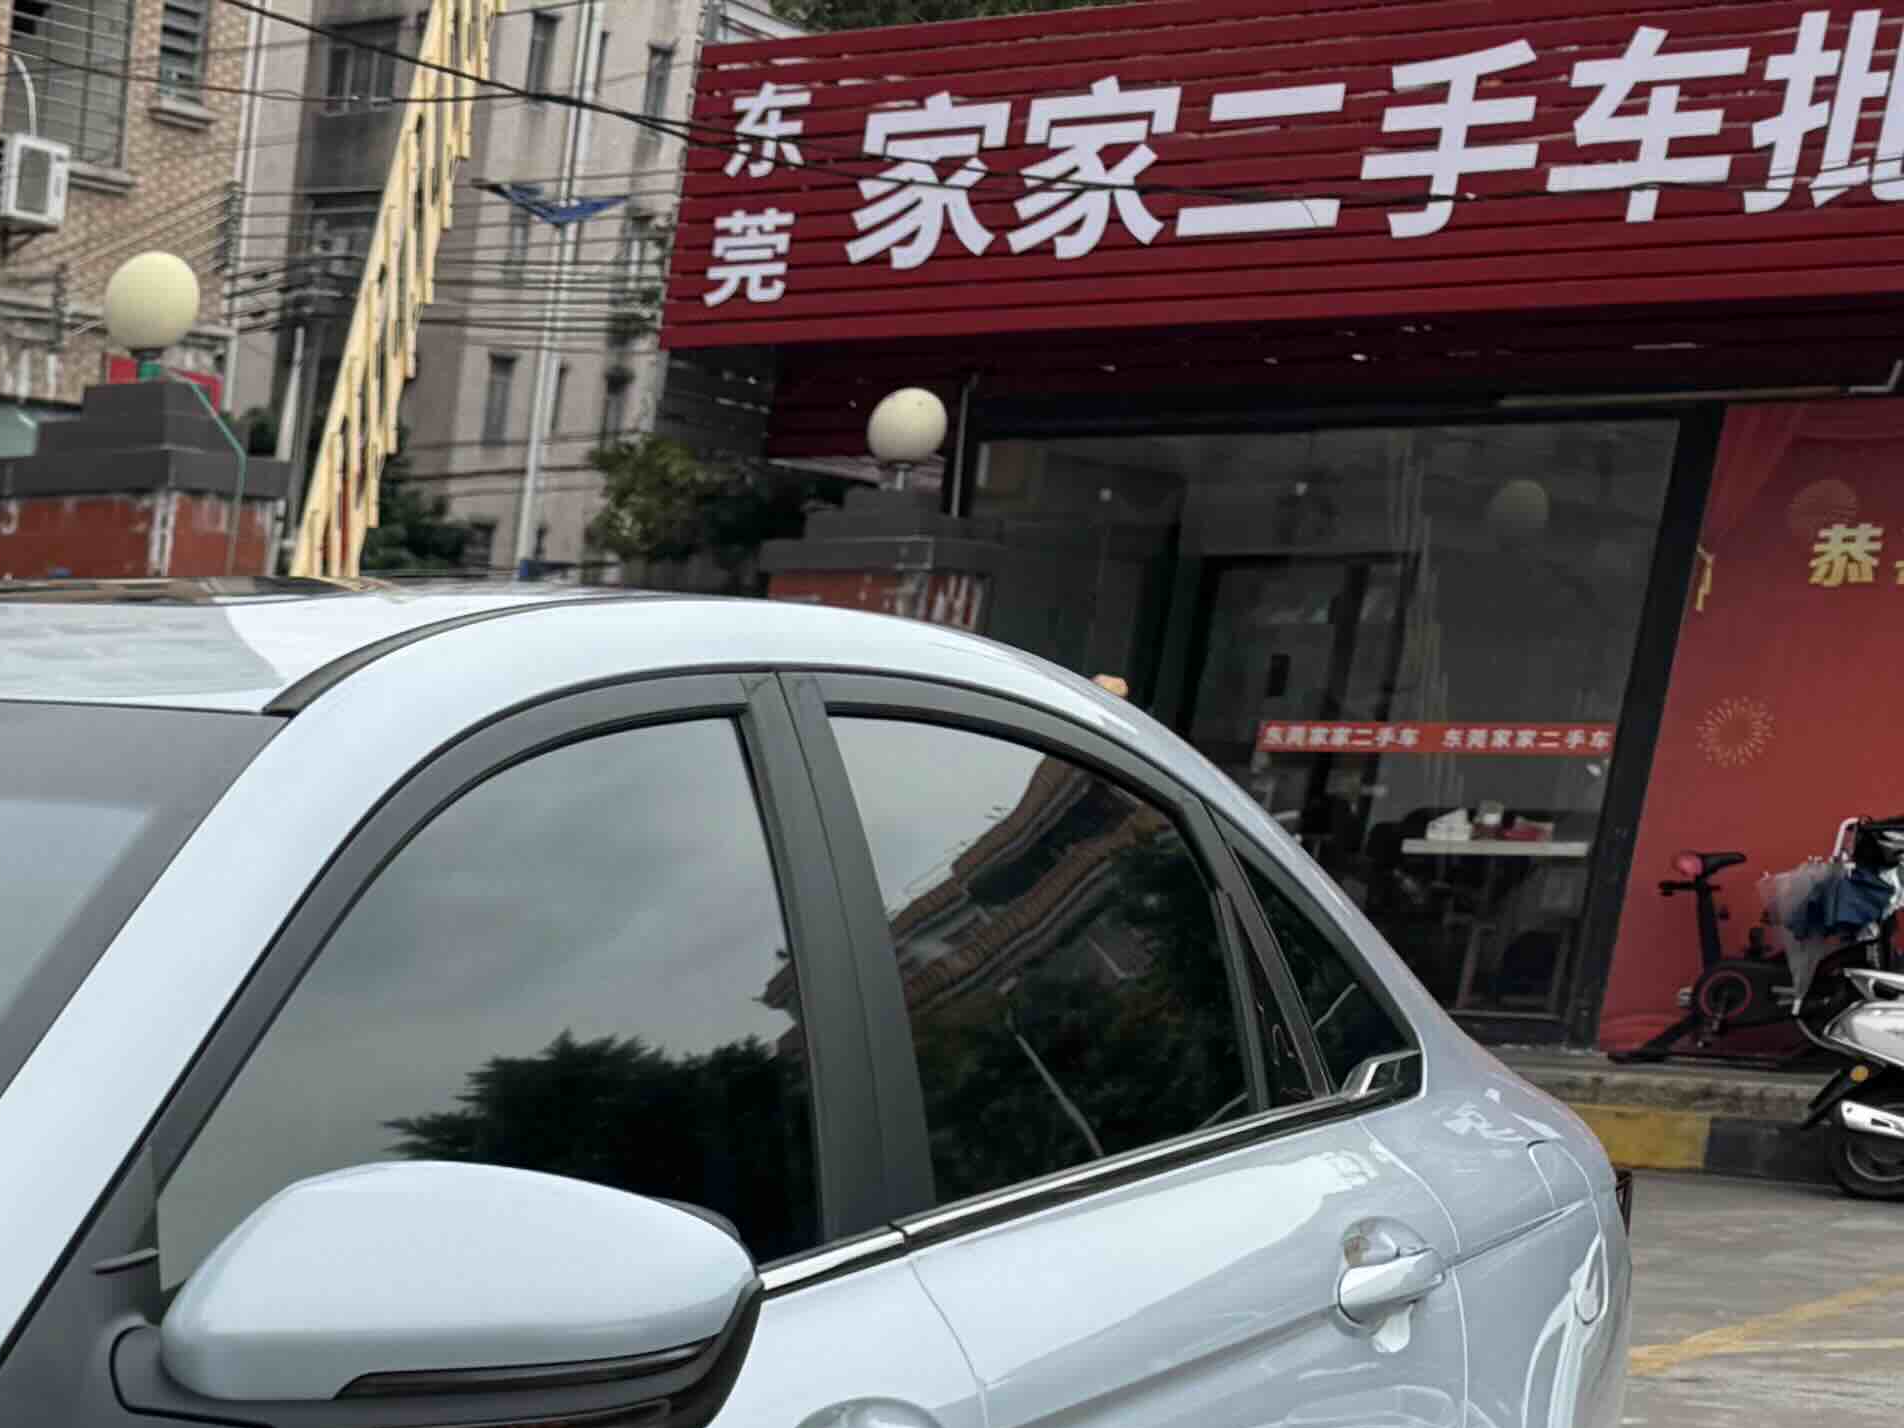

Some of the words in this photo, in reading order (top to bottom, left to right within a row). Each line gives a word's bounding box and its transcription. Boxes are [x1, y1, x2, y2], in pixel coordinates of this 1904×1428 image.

[703, 82, 811, 307] 东莞
[844, 9, 1904, 270] 家家二手车批
[1808, 523, 1904, 588] 恭
[1263, 725, 1420, 749] 东莞家家二手车
[1442, 729, 1614, 750] 东莞家家二手车
